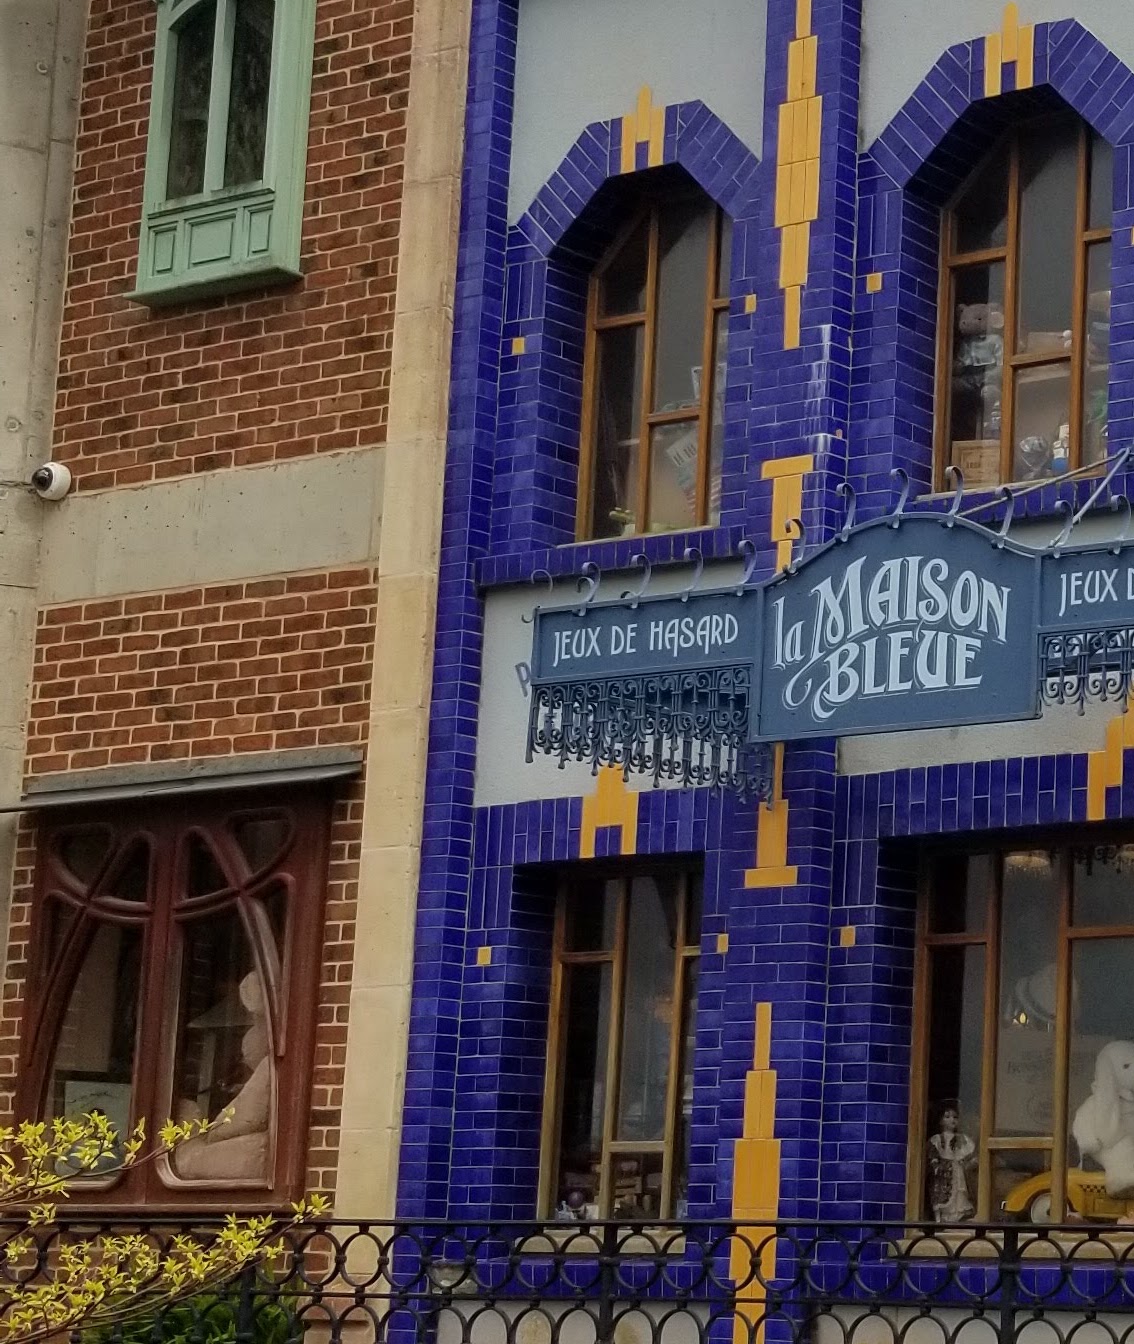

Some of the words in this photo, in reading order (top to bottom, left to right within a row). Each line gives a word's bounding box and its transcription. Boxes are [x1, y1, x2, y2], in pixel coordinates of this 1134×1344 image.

[1057, 567, 1118, 617] JEUX
[552, 628, 602, 667] JEUX
[610, 623, 638, 656] DE
[649, 613, 739, 657] HASARD
[783, 555, 1012, 709] MAISON
[811, 628, 983, 722] BLEUE
